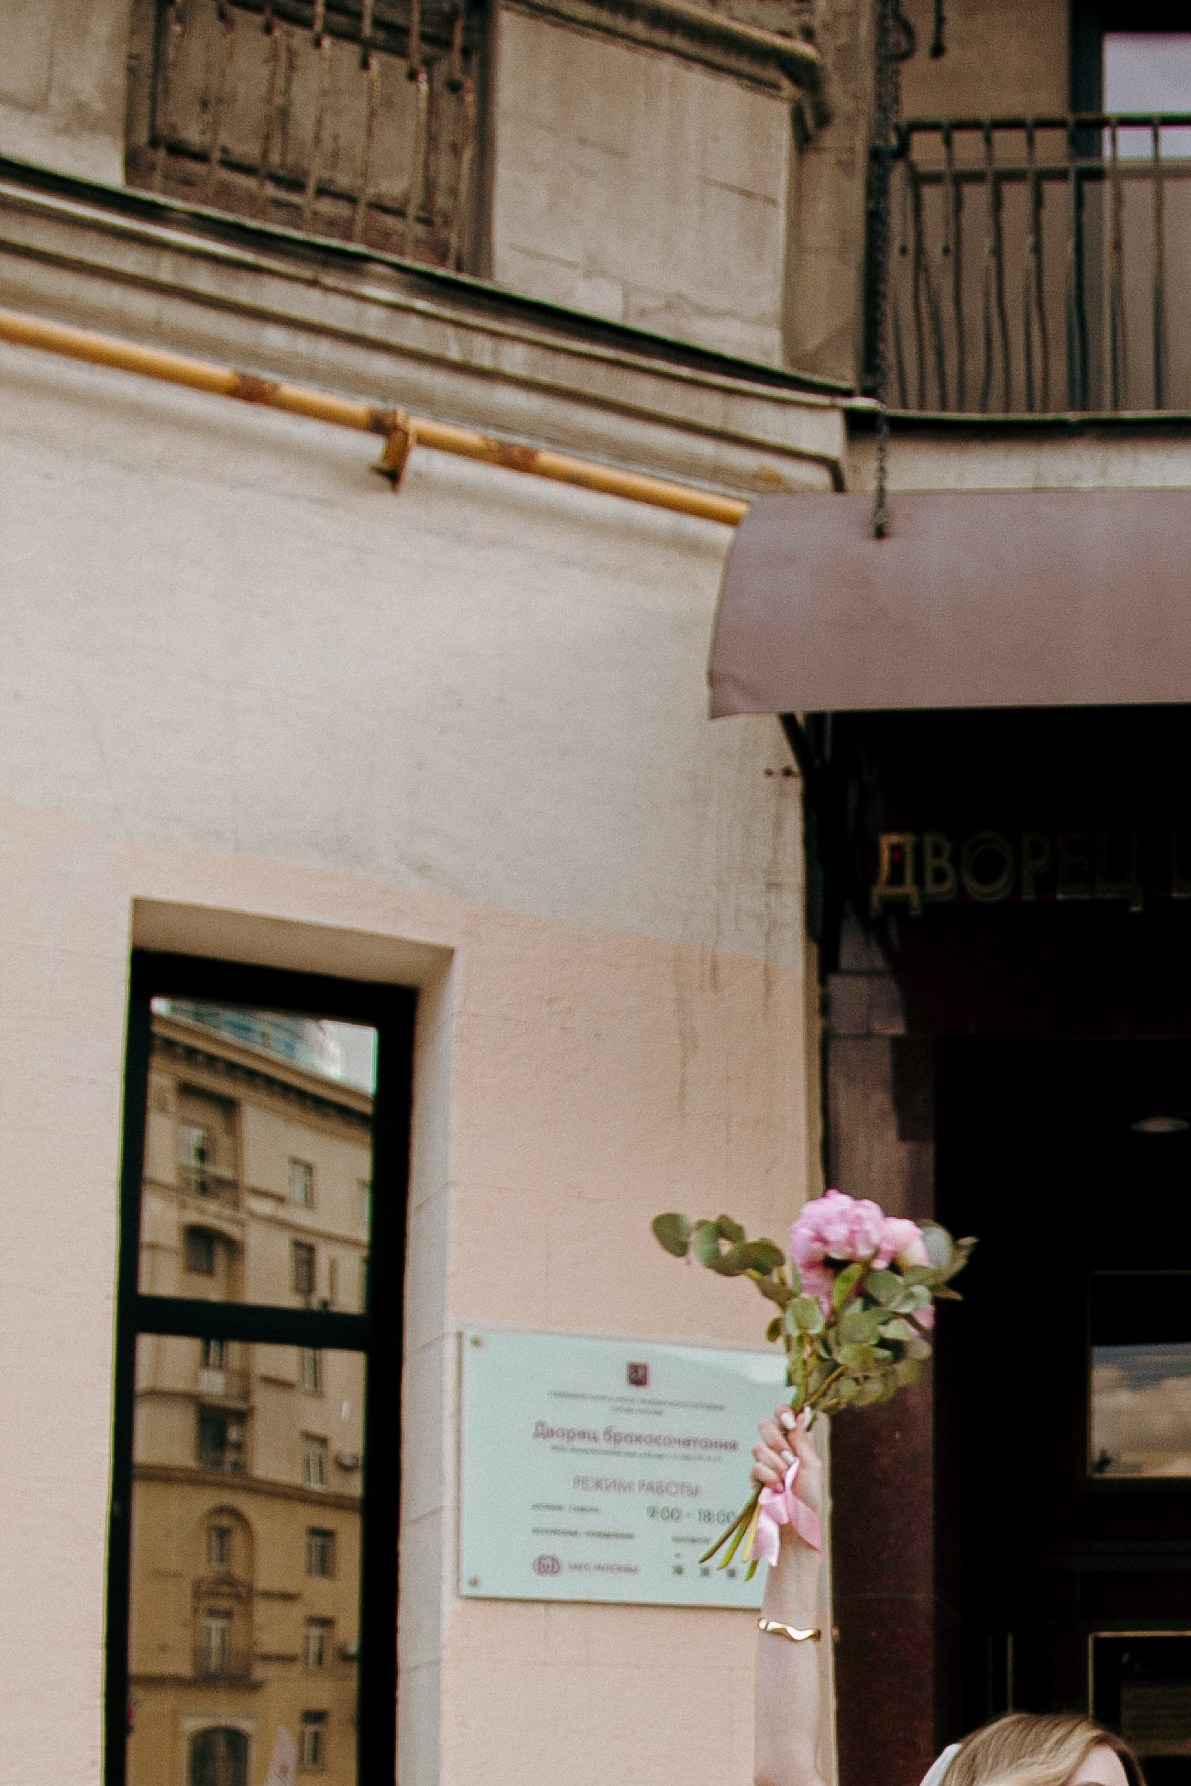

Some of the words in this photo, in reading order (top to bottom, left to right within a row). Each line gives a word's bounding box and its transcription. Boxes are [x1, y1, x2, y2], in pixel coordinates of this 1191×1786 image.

[869, 830, 1144, 917] ДВОРЕЦ
[532, 1420, 599, 1443] Дворец
[602, 1425, 739, 1451] бракосочетания
[573, 1476, 633, 1494] РЕЖИМ
[638, 1479, 701, 1498] РАБОТЫ
[647, 1505, 682, 1521] 9:00
